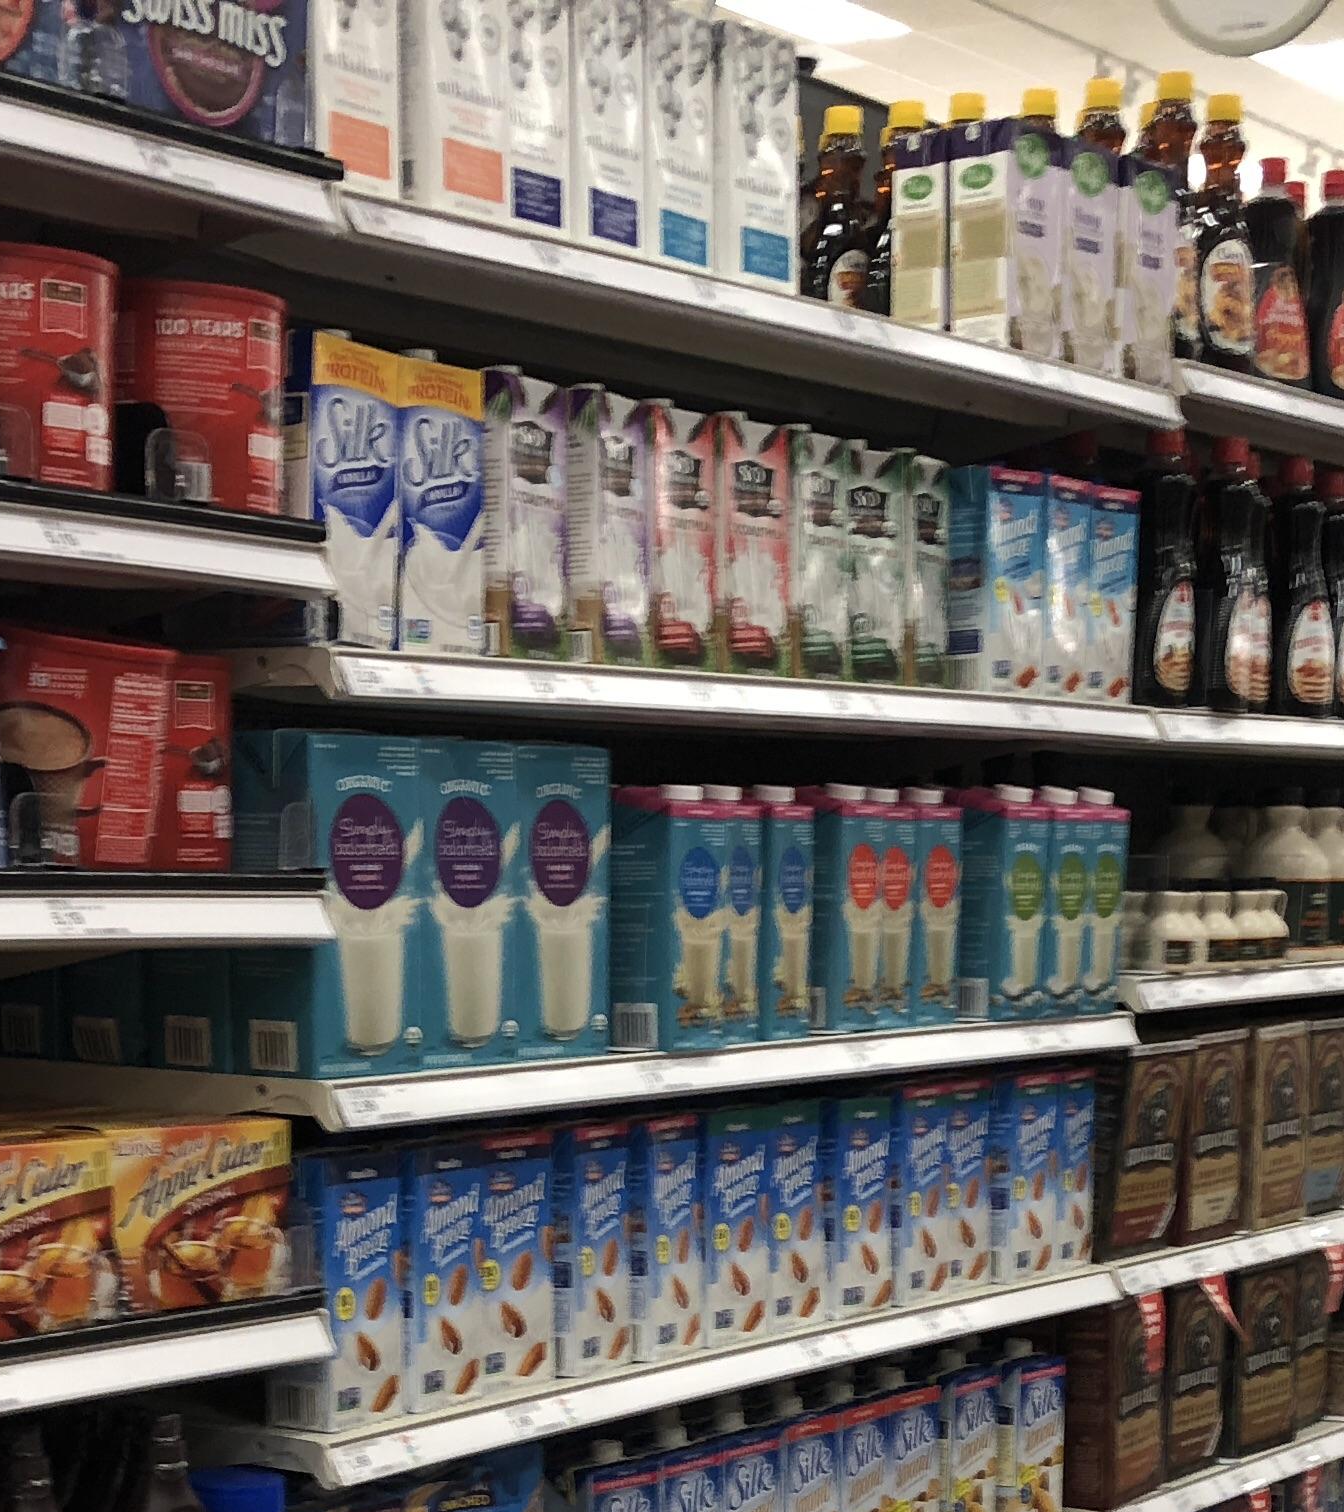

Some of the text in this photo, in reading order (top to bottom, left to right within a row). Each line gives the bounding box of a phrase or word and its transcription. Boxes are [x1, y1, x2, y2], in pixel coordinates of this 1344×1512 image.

[315, 396, 394, 469] Silk
[402, 414, 481, 488] Silk
[728, 1457, 777, 1511] Silk
